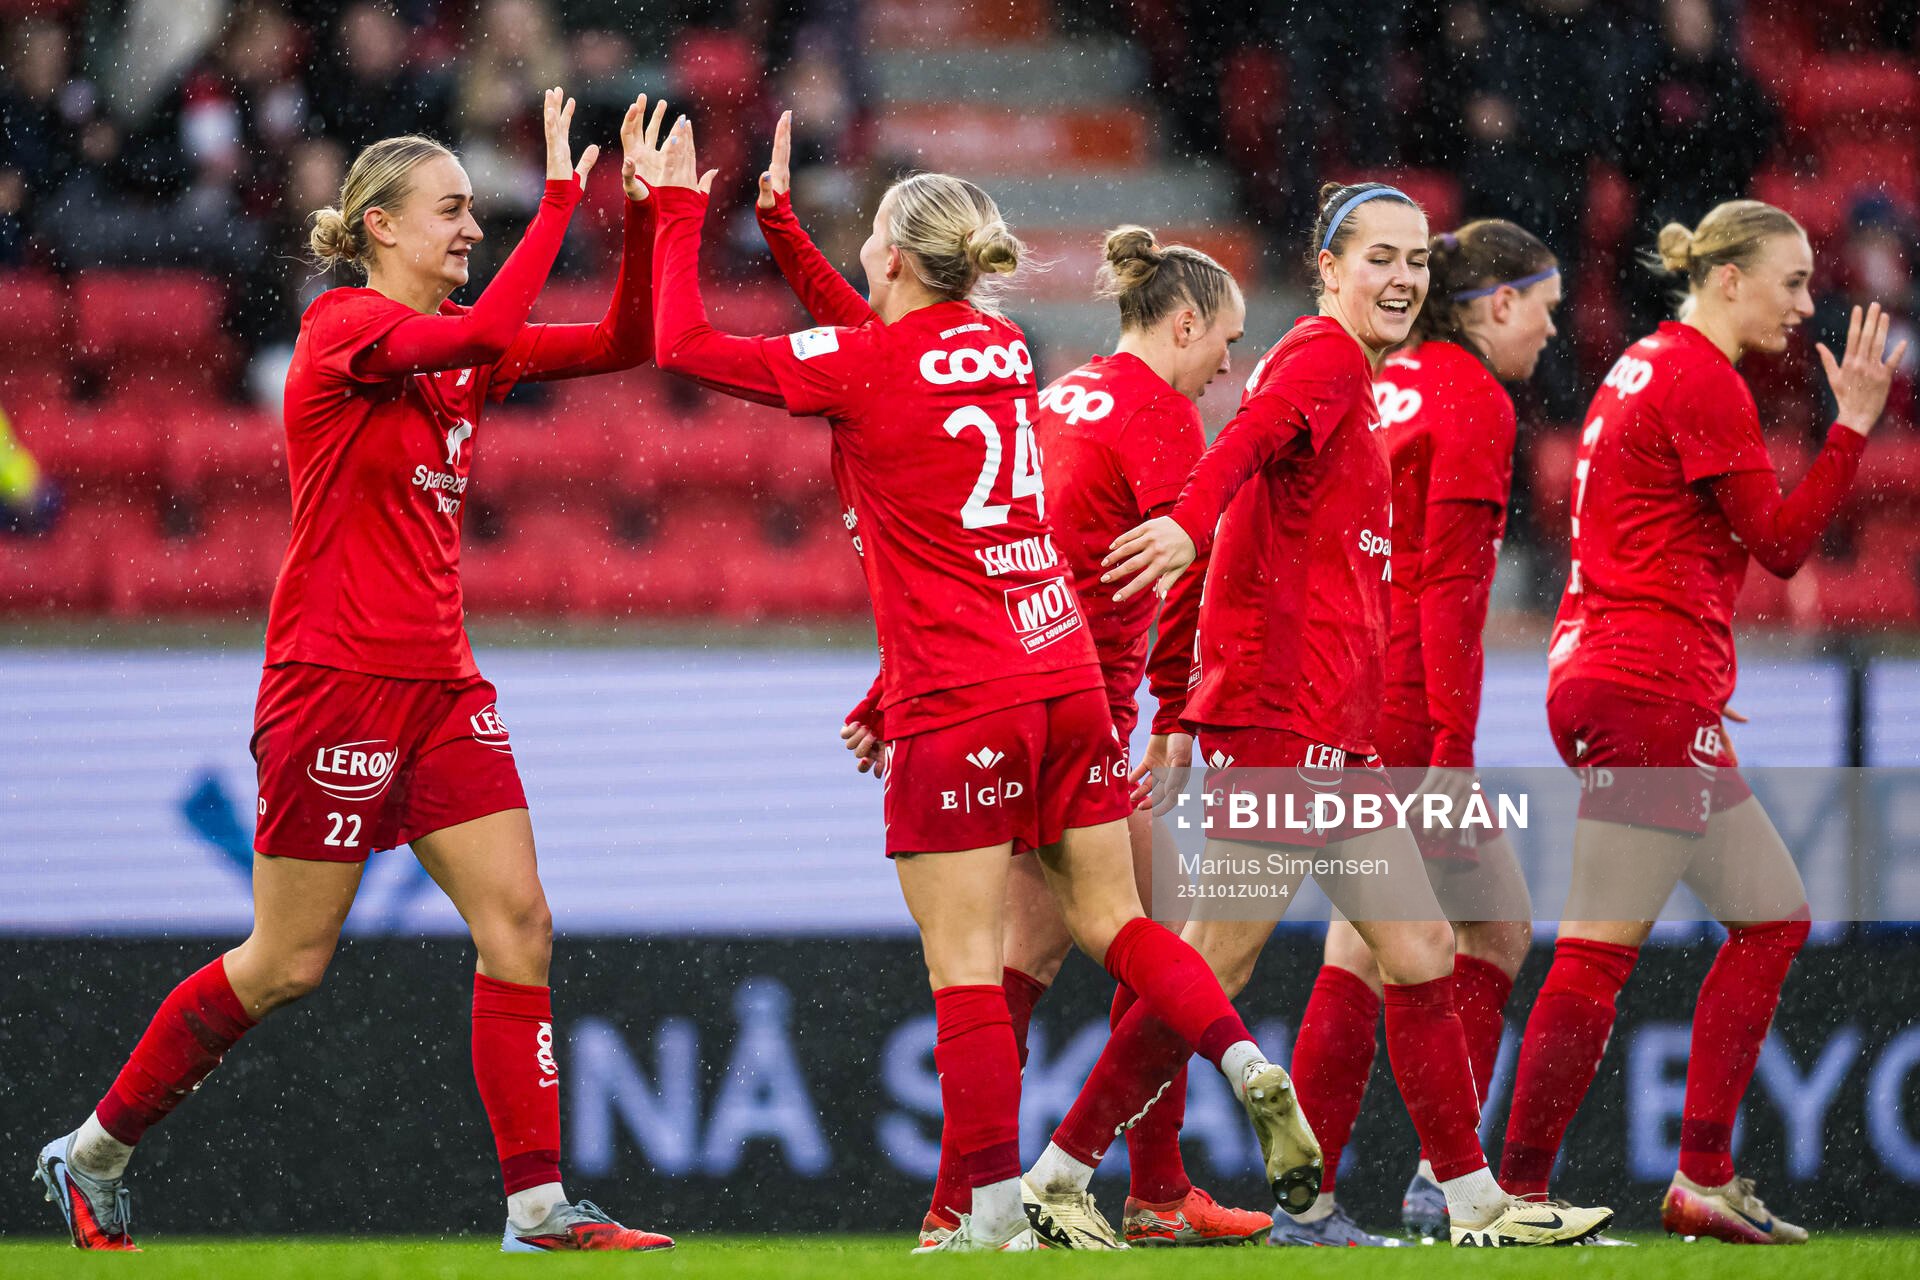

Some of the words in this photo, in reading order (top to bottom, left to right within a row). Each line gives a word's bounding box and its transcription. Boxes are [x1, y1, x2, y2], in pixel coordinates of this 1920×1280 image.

[919, 339, 1033, 385] coop
[943, 398, 1044, 530] 24
[975, 534, 1058, 577] LEHTOLA
[1018, 579, 1073, 631] MOT
[315, 747, 396, 777] LERØY
[324, 812, 362, 848] 22
[570, 975, 832, 1180] NÅ
